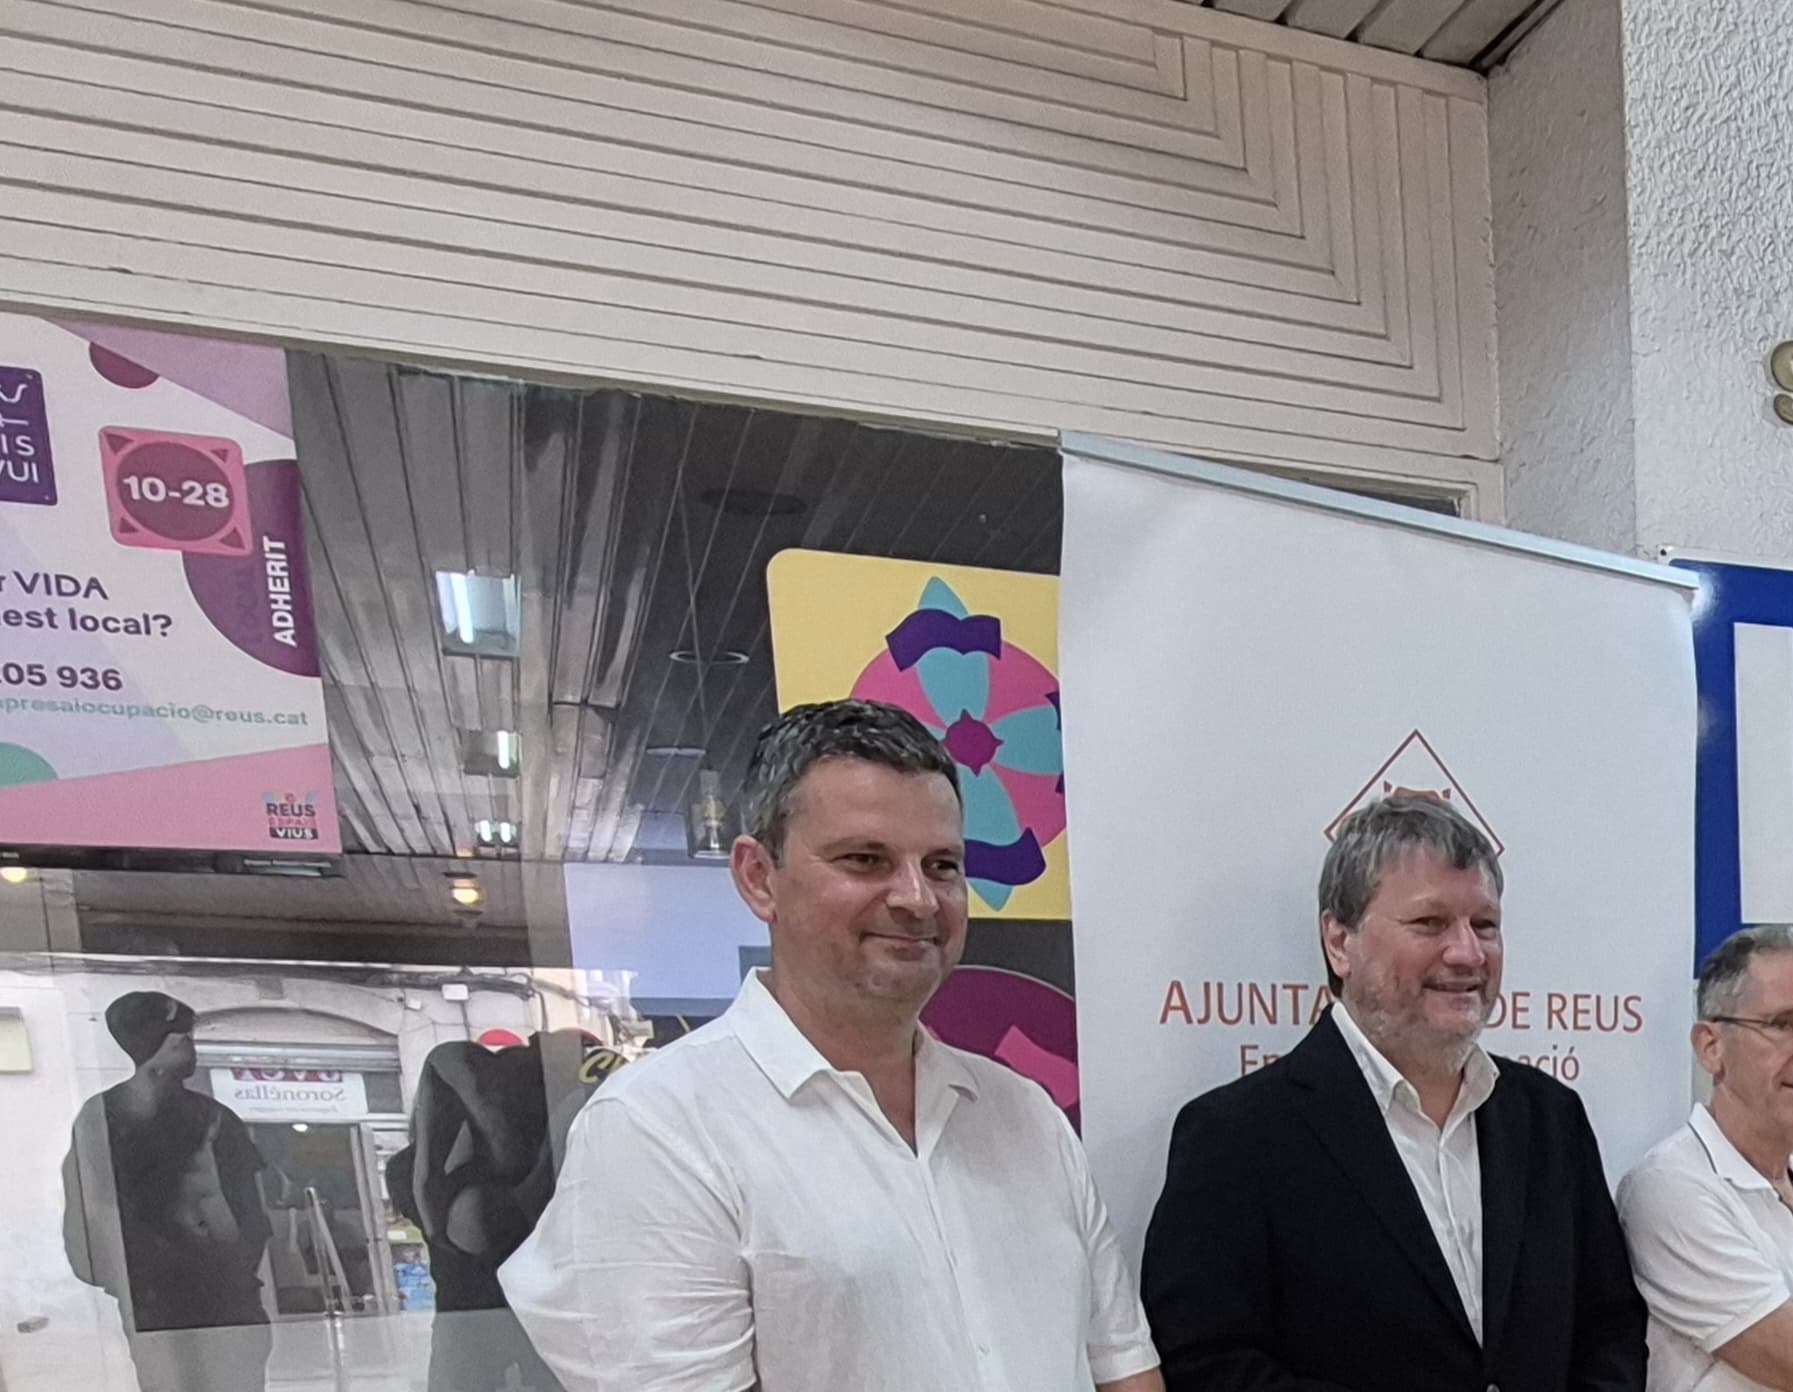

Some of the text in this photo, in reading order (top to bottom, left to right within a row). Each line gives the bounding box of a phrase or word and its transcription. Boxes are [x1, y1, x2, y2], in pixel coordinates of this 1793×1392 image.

[122, 475, 229, 508] 10-28
[12, 570, 110, 600] VIDA
[262, 535, 297, 647] ADHERIT
[3, 607, 173, 637] est local?
[0, 662, 123, 691] 05 936
[266, 802, 316, 816] REUS
[1159, 979, 1643, 1033] AJUNTA DE REUS
